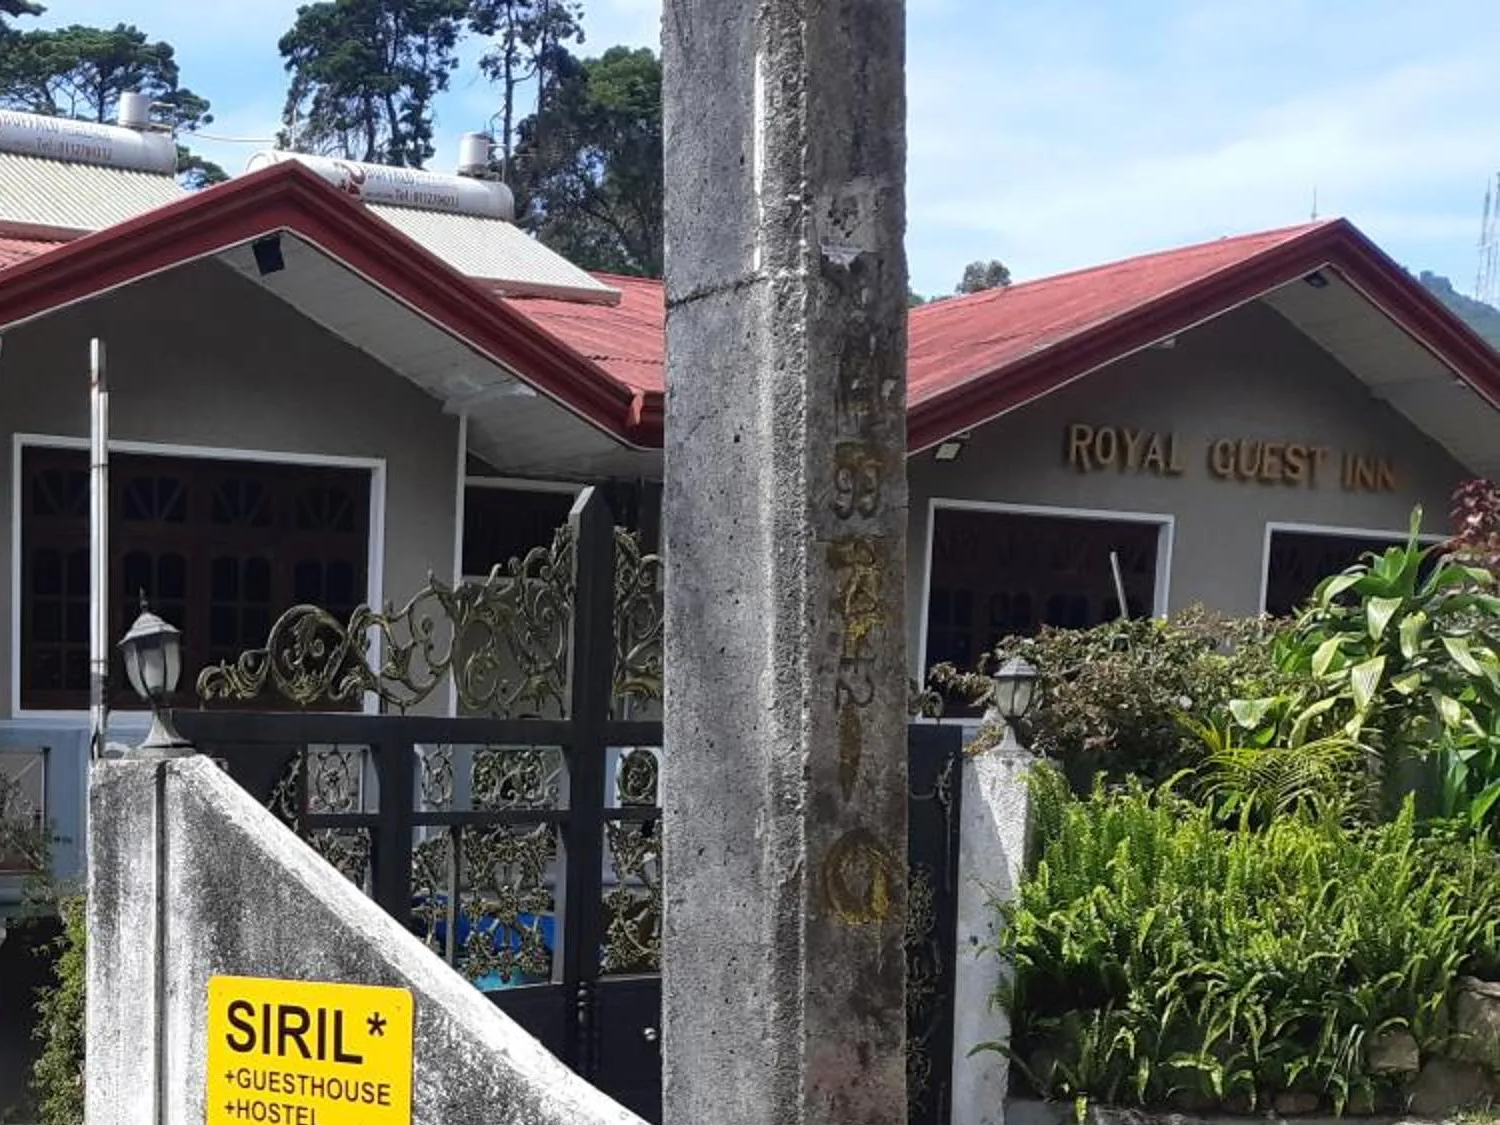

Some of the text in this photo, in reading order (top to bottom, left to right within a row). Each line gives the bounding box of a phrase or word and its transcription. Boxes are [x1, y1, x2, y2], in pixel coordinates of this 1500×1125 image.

[1068, 423, 1399, 494] ROYAL GUEST INN
